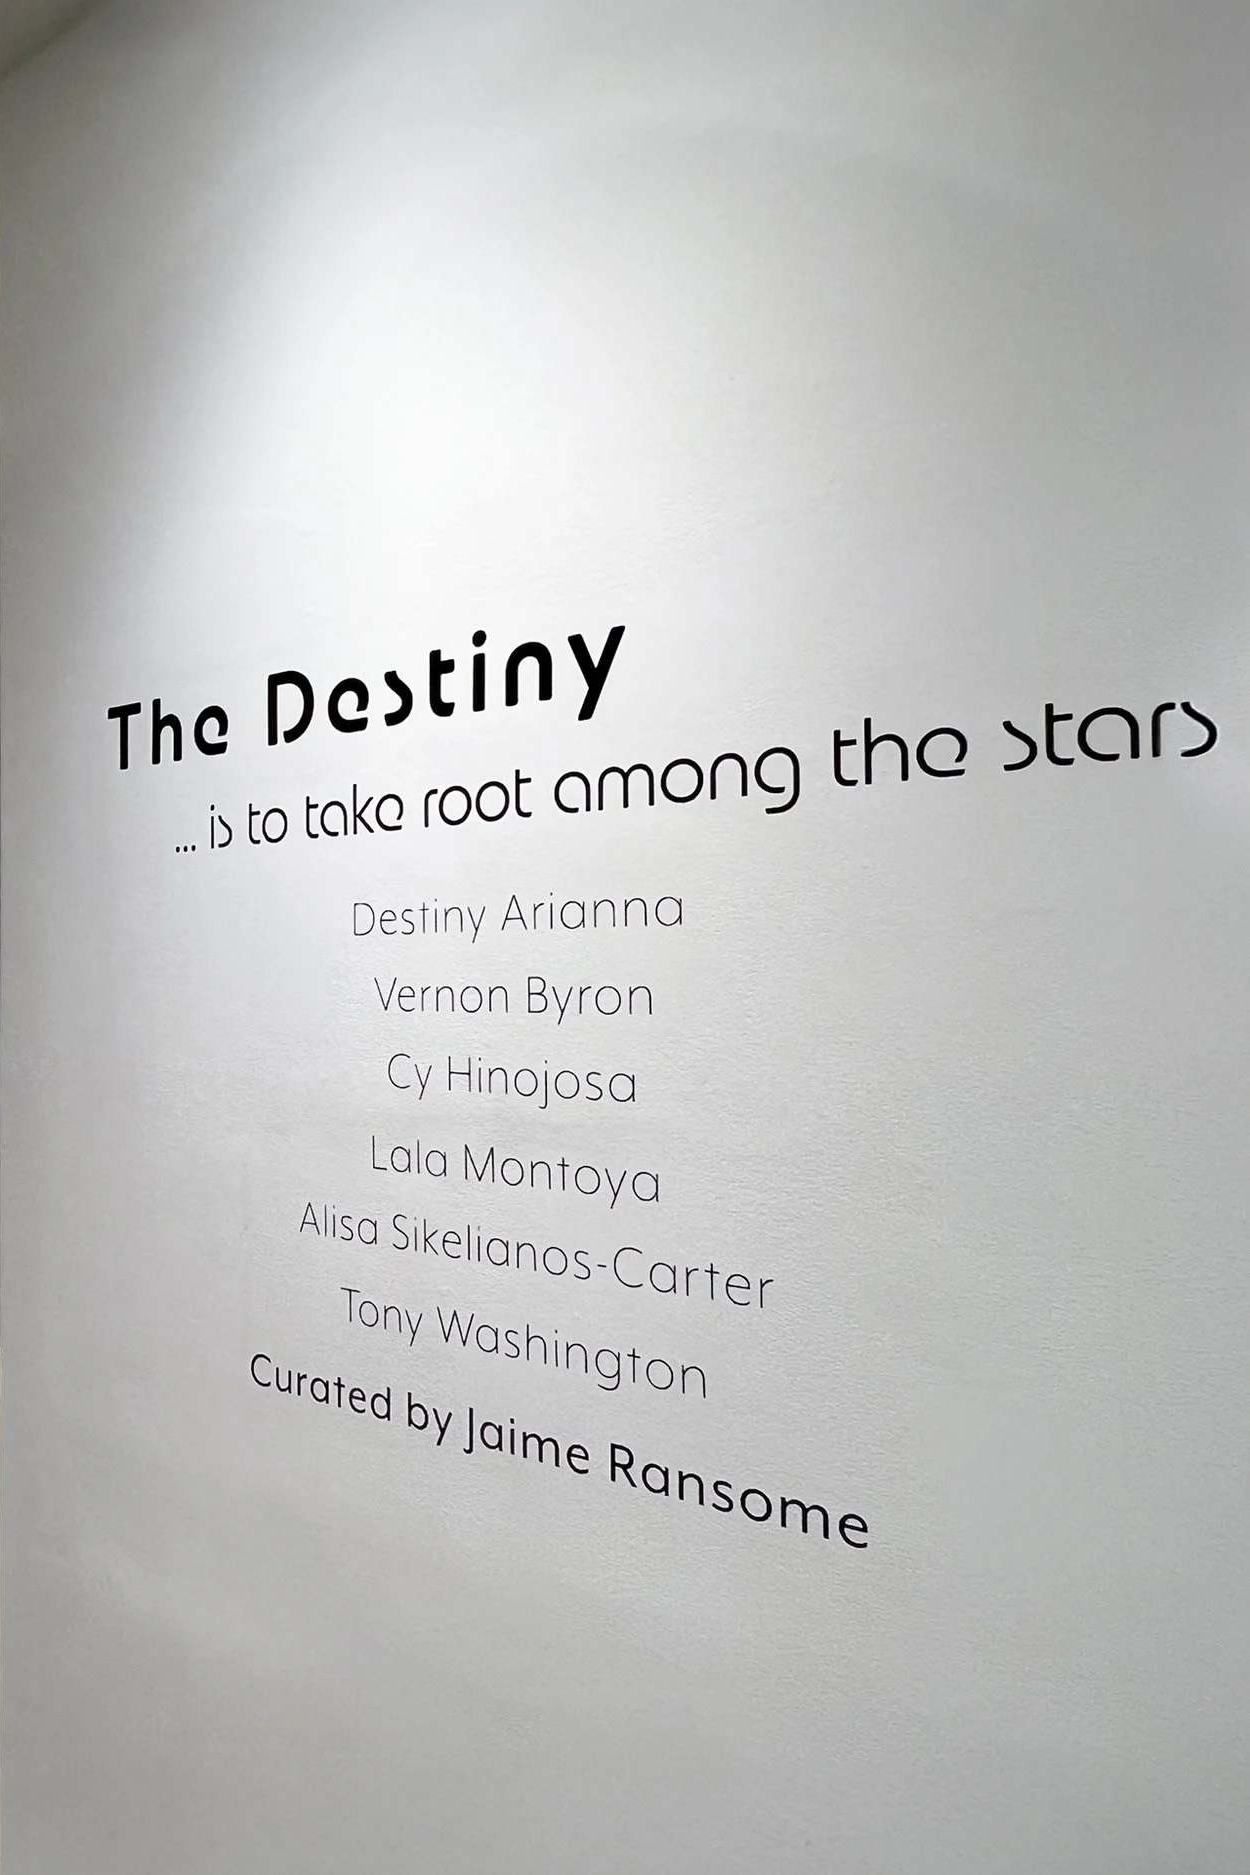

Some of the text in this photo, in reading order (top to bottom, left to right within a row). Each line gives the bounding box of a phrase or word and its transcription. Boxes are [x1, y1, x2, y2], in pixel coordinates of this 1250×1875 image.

[108, 625, 626, 770] The Destiny
[210, 804, 233, 849] is
[249, 803, 288, 845] to
[306, 784, 404, 839] take
[424, 769, 532, 828] root
[554, 747, 800, 814] among
[833, 717, 968, 786] the
[1002, 701, 1217, 771] stars
[354, 892, 682, 944] Destiny Arianna
[374, 976, 652, 1026] Vernon Byron
[388, 1053, 635, 1109] Cy Hinojosa
[372, 1135, 659, 1209] Lala Montoya
[300, 1202, 774, 1308] Alisa Sikelianos-Carter
[340, 1287, 706, 1399] Tony Washington
[251, 1354, 868, 1548] Curated by Jaime Ransome
